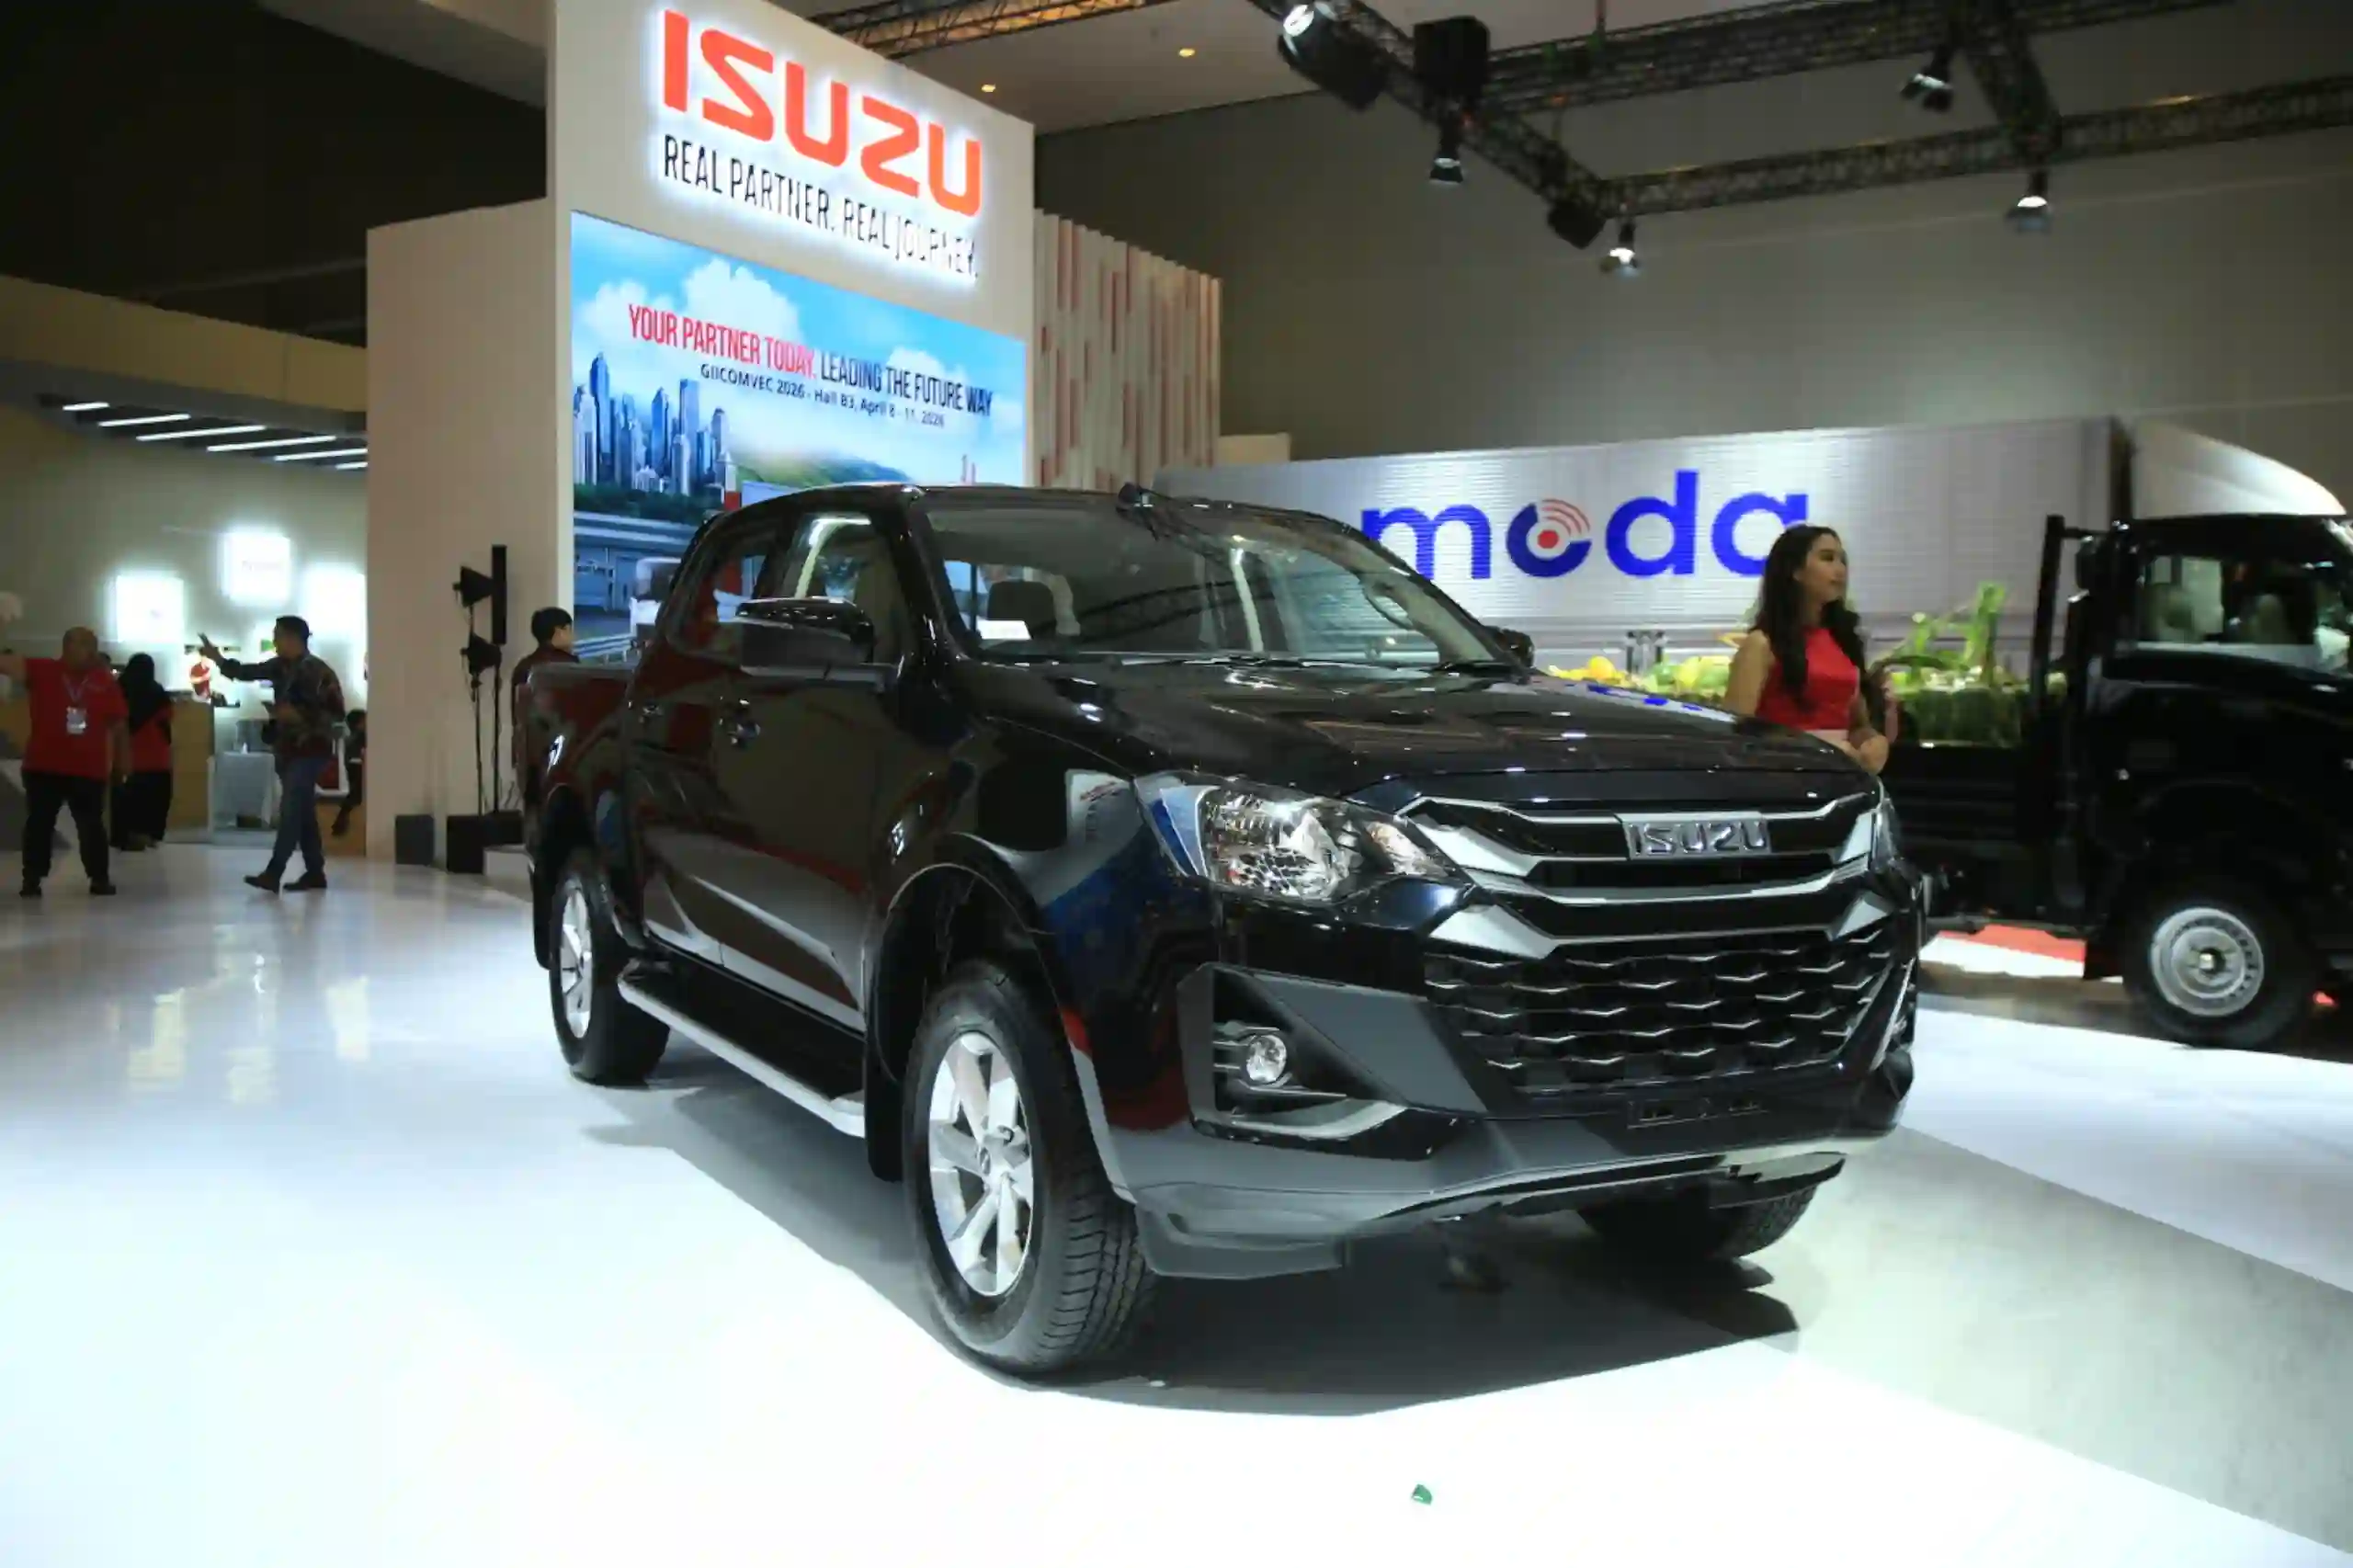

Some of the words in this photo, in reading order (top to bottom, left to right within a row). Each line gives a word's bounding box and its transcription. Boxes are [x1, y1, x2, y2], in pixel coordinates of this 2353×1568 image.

[664, 9, 983, 218] ISUZU
[664, 133, 723, 195] REAL
[844, 197, 891, 250] REAL
[629, 303, 677, 348] YOUR
[683, 316, 762, 366] PARTNER
[764, 335, 817, 379] TODAY.
[821, 352, 882, 393] LEADING
[885, 366, 912, 400] THE
[915, 372, 963, 412] FUTURE
[966, 384, 994, 417] WAY
[700, 362, 774, 392] GIICOMVEC
[777, 379, 806, 400] 2026
[814, 389, 837, 406] Hall
[859, 397, 887, 417] April
[1360, 469, 1809, 579] moda
[1629, 821, 1768, 857] ISUZU
